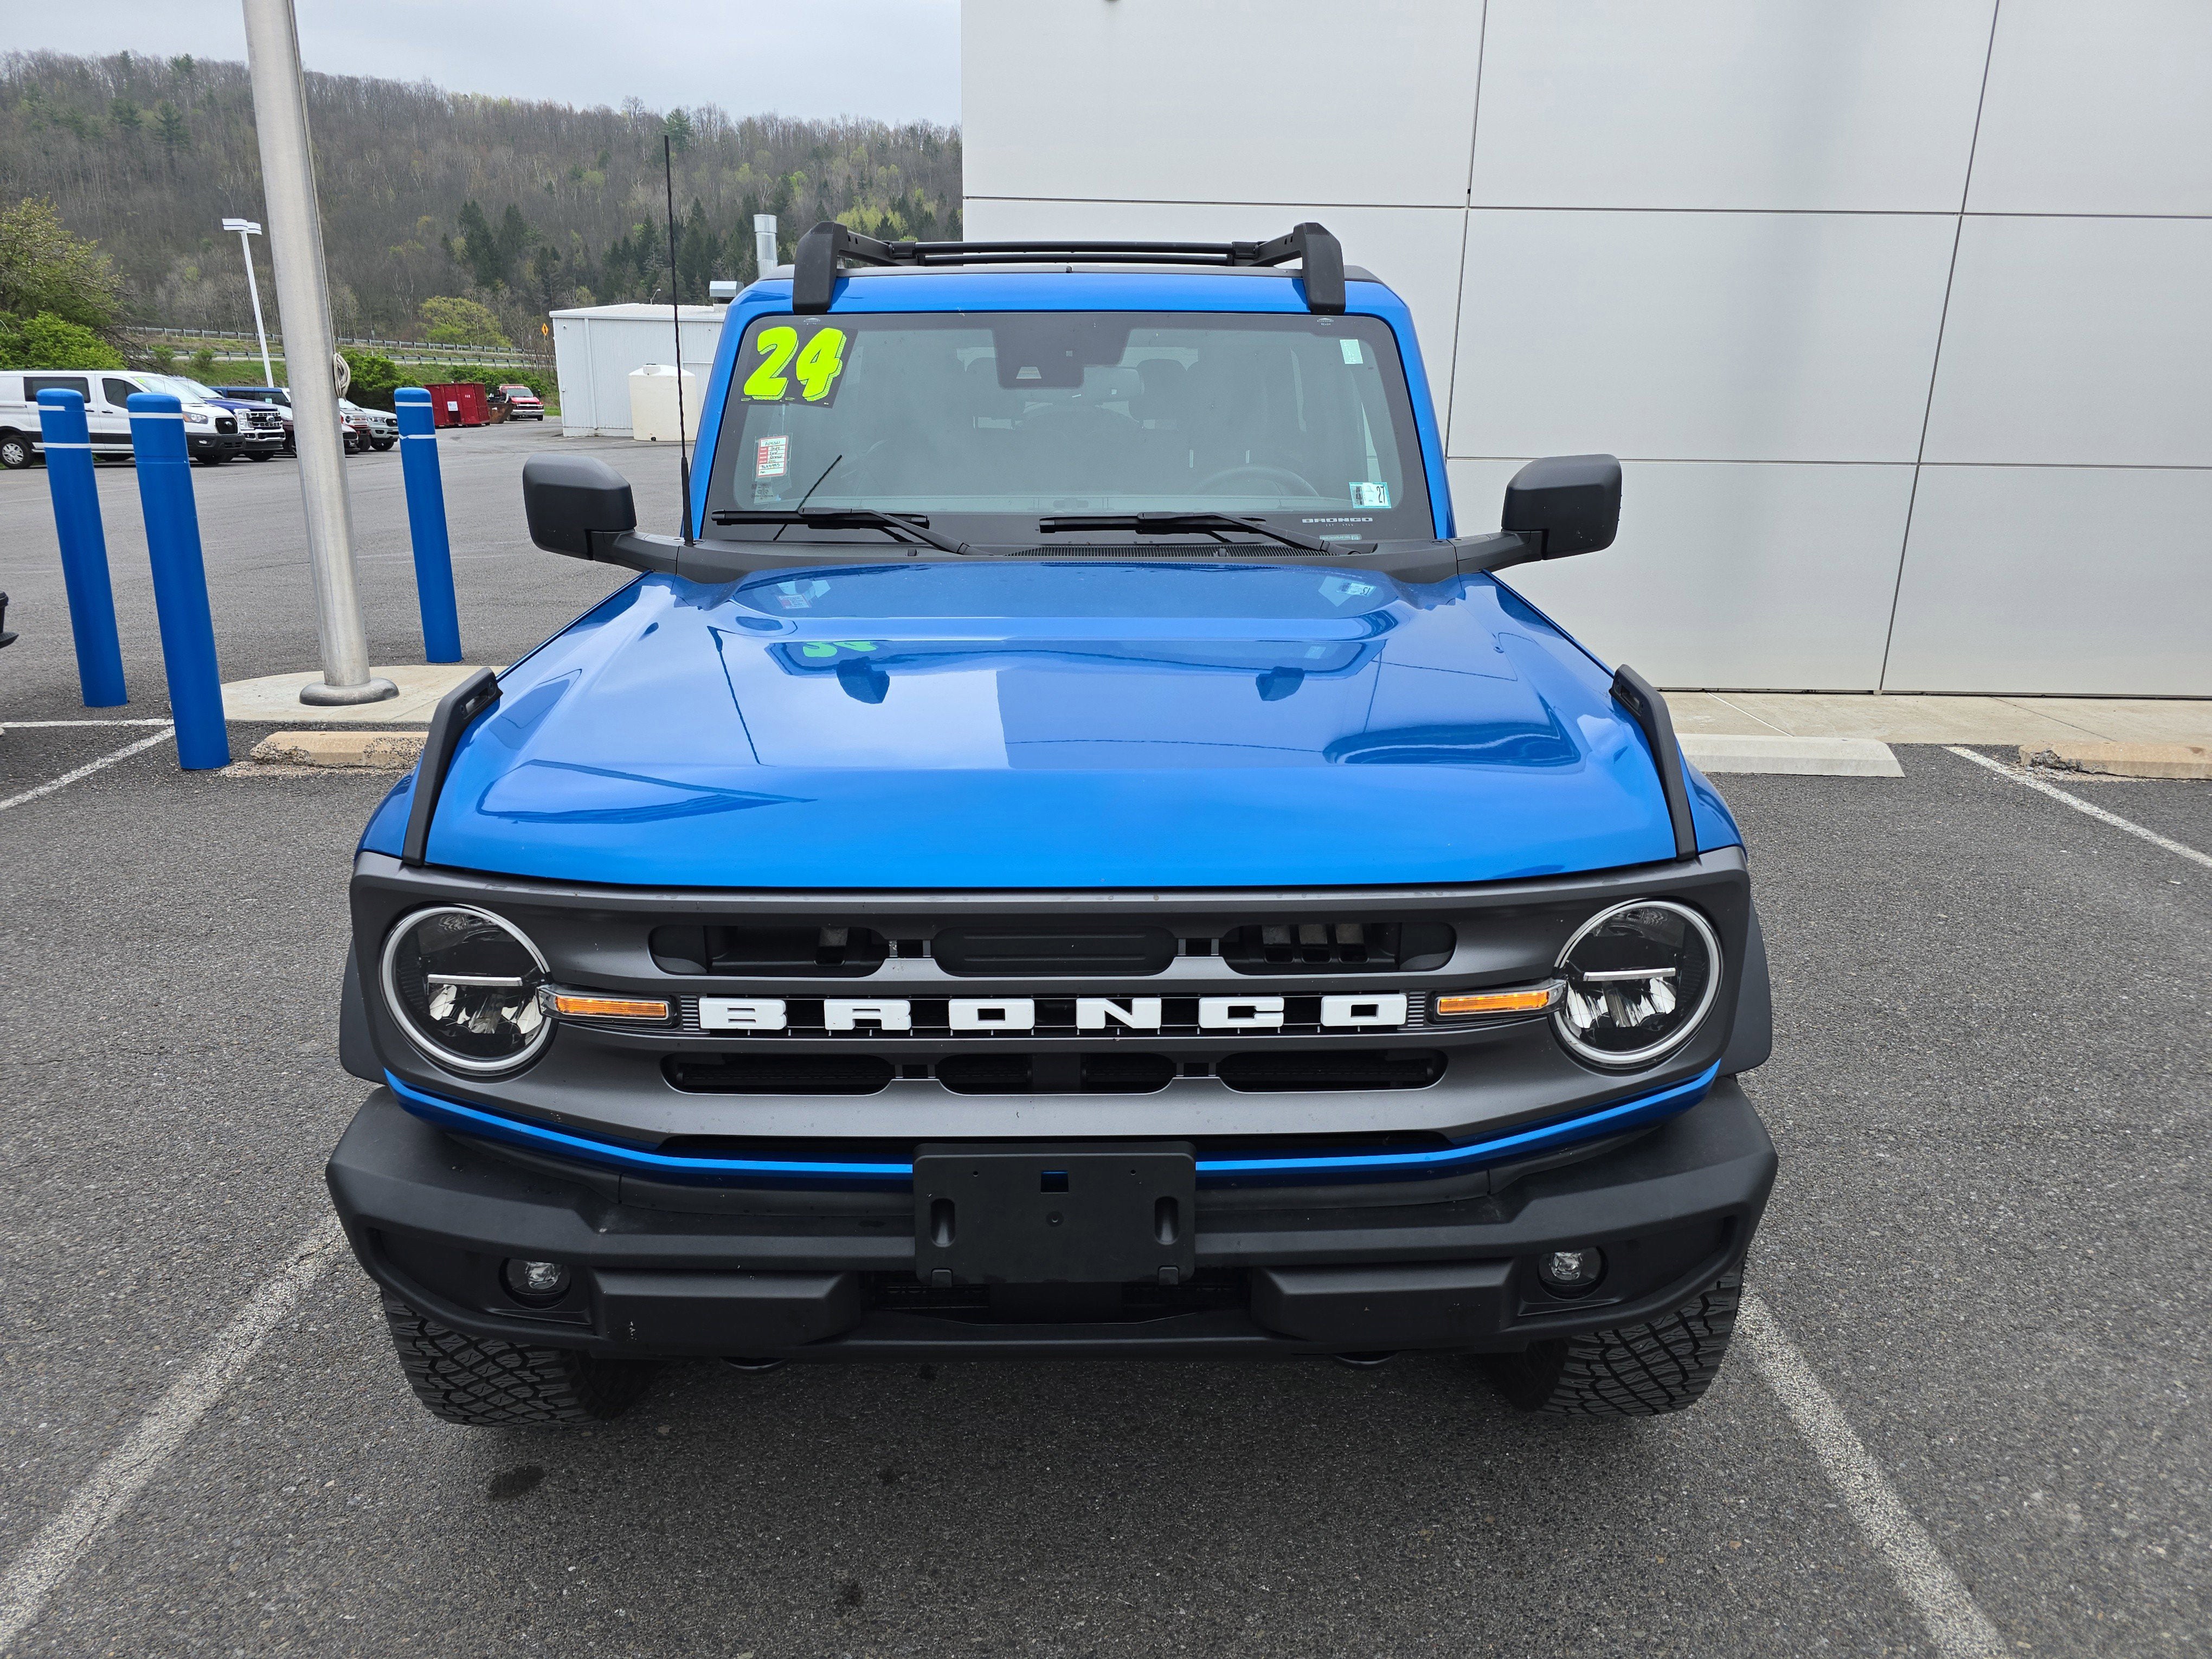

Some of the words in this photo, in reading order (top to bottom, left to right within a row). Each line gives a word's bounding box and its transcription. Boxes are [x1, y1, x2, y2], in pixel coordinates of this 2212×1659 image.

[744, 326, 847, 402] 24
[1376, 486, 1386, 504] 27
[699, 994, 1406, 1030] BRONCO
